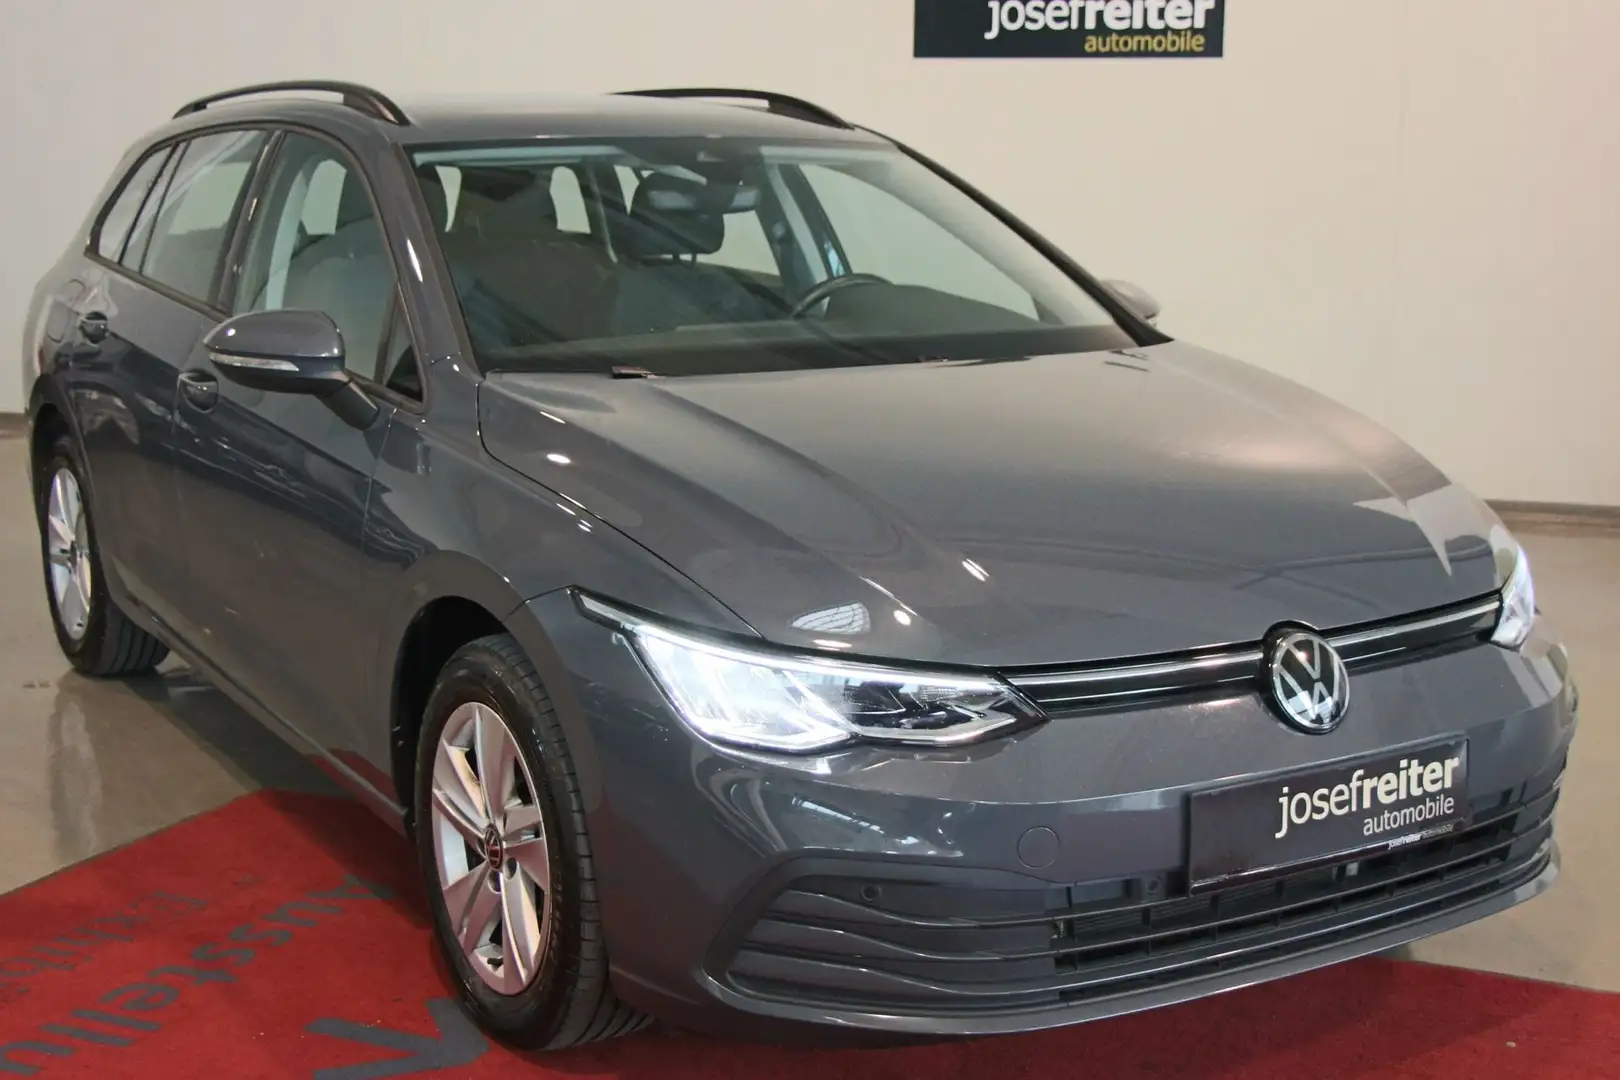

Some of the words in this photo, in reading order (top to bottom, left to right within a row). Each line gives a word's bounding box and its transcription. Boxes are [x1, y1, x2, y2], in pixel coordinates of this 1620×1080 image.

[984, 0, 1216, 40] josefreiter
[1084, 31, 1205, 52] automobile
[1275, 756, 1460, 839] josefreiter
[1363, 795, 1455, 836] automobile
